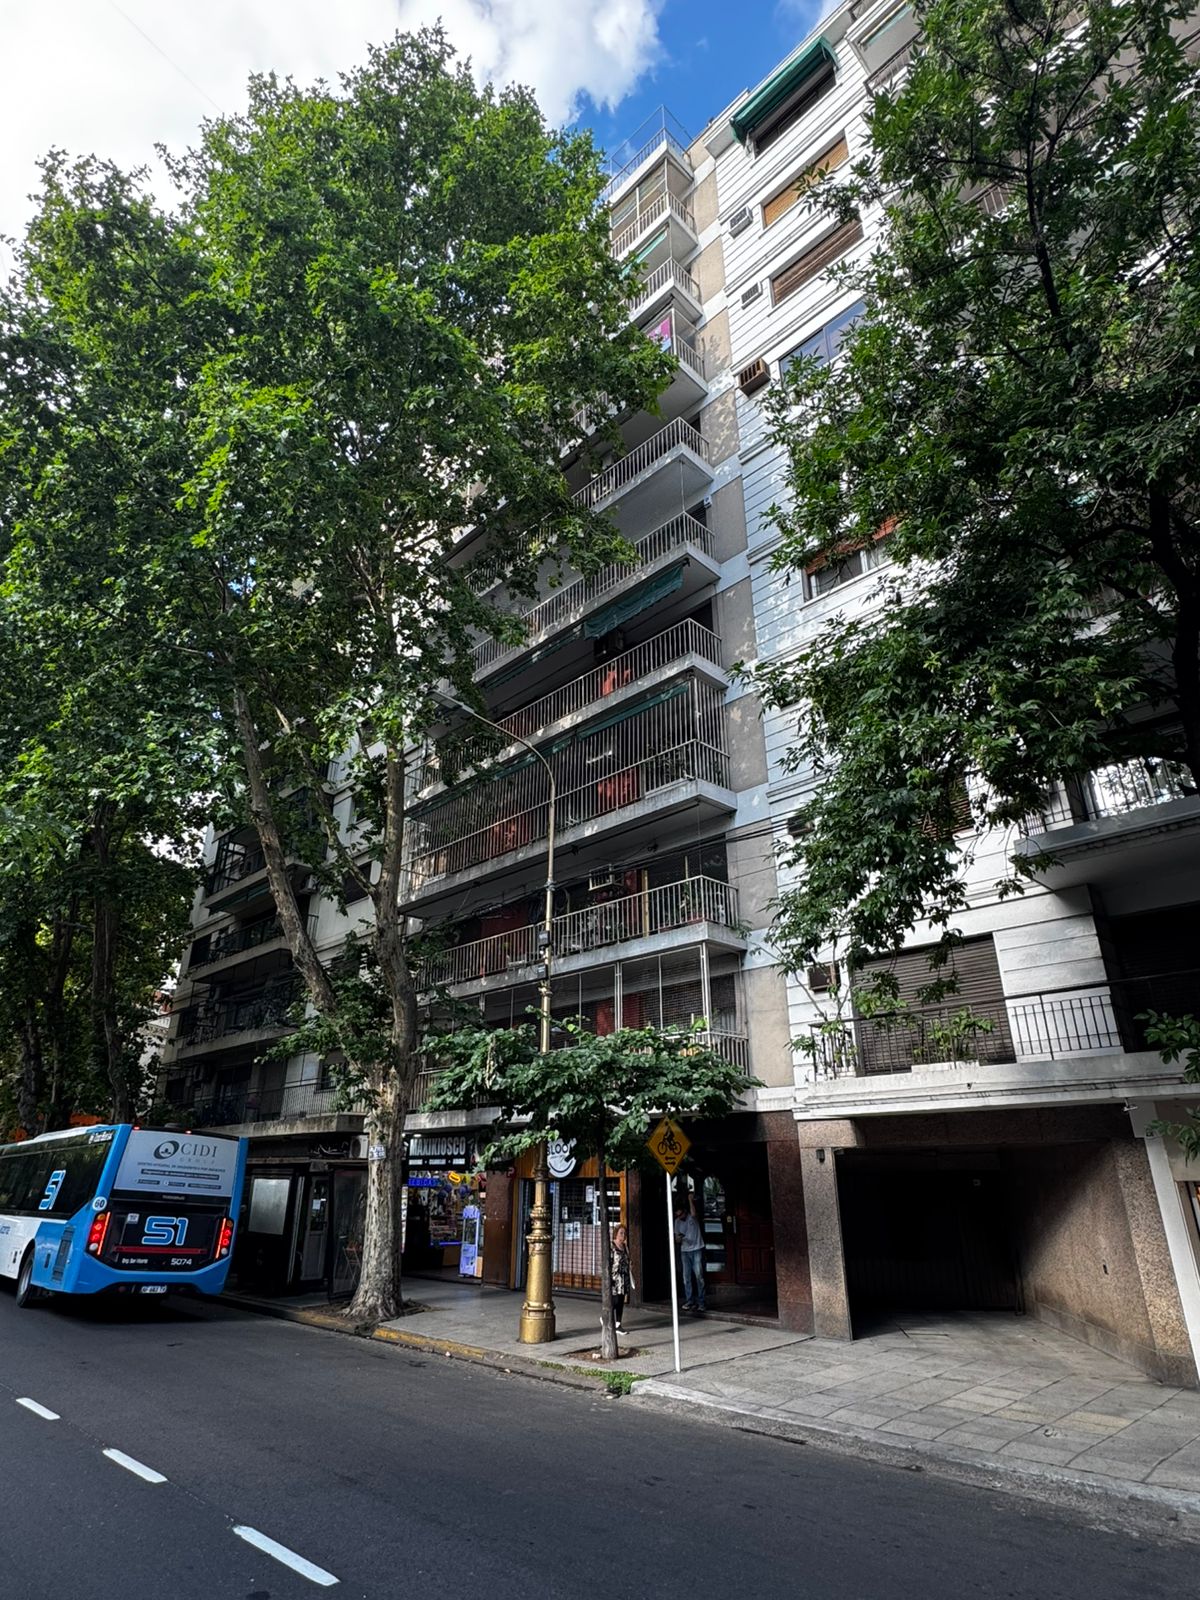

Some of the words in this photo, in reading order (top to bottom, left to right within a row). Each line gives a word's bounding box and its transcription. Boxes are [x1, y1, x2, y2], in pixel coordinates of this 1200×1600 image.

[180, 1142, 218, 1158] CIDI
[409, 1136, 466, 1156] MAXIKIOSCO
[94, 1199, 105, 1208] 60
[170, 1257, 193, 1266] 5074
